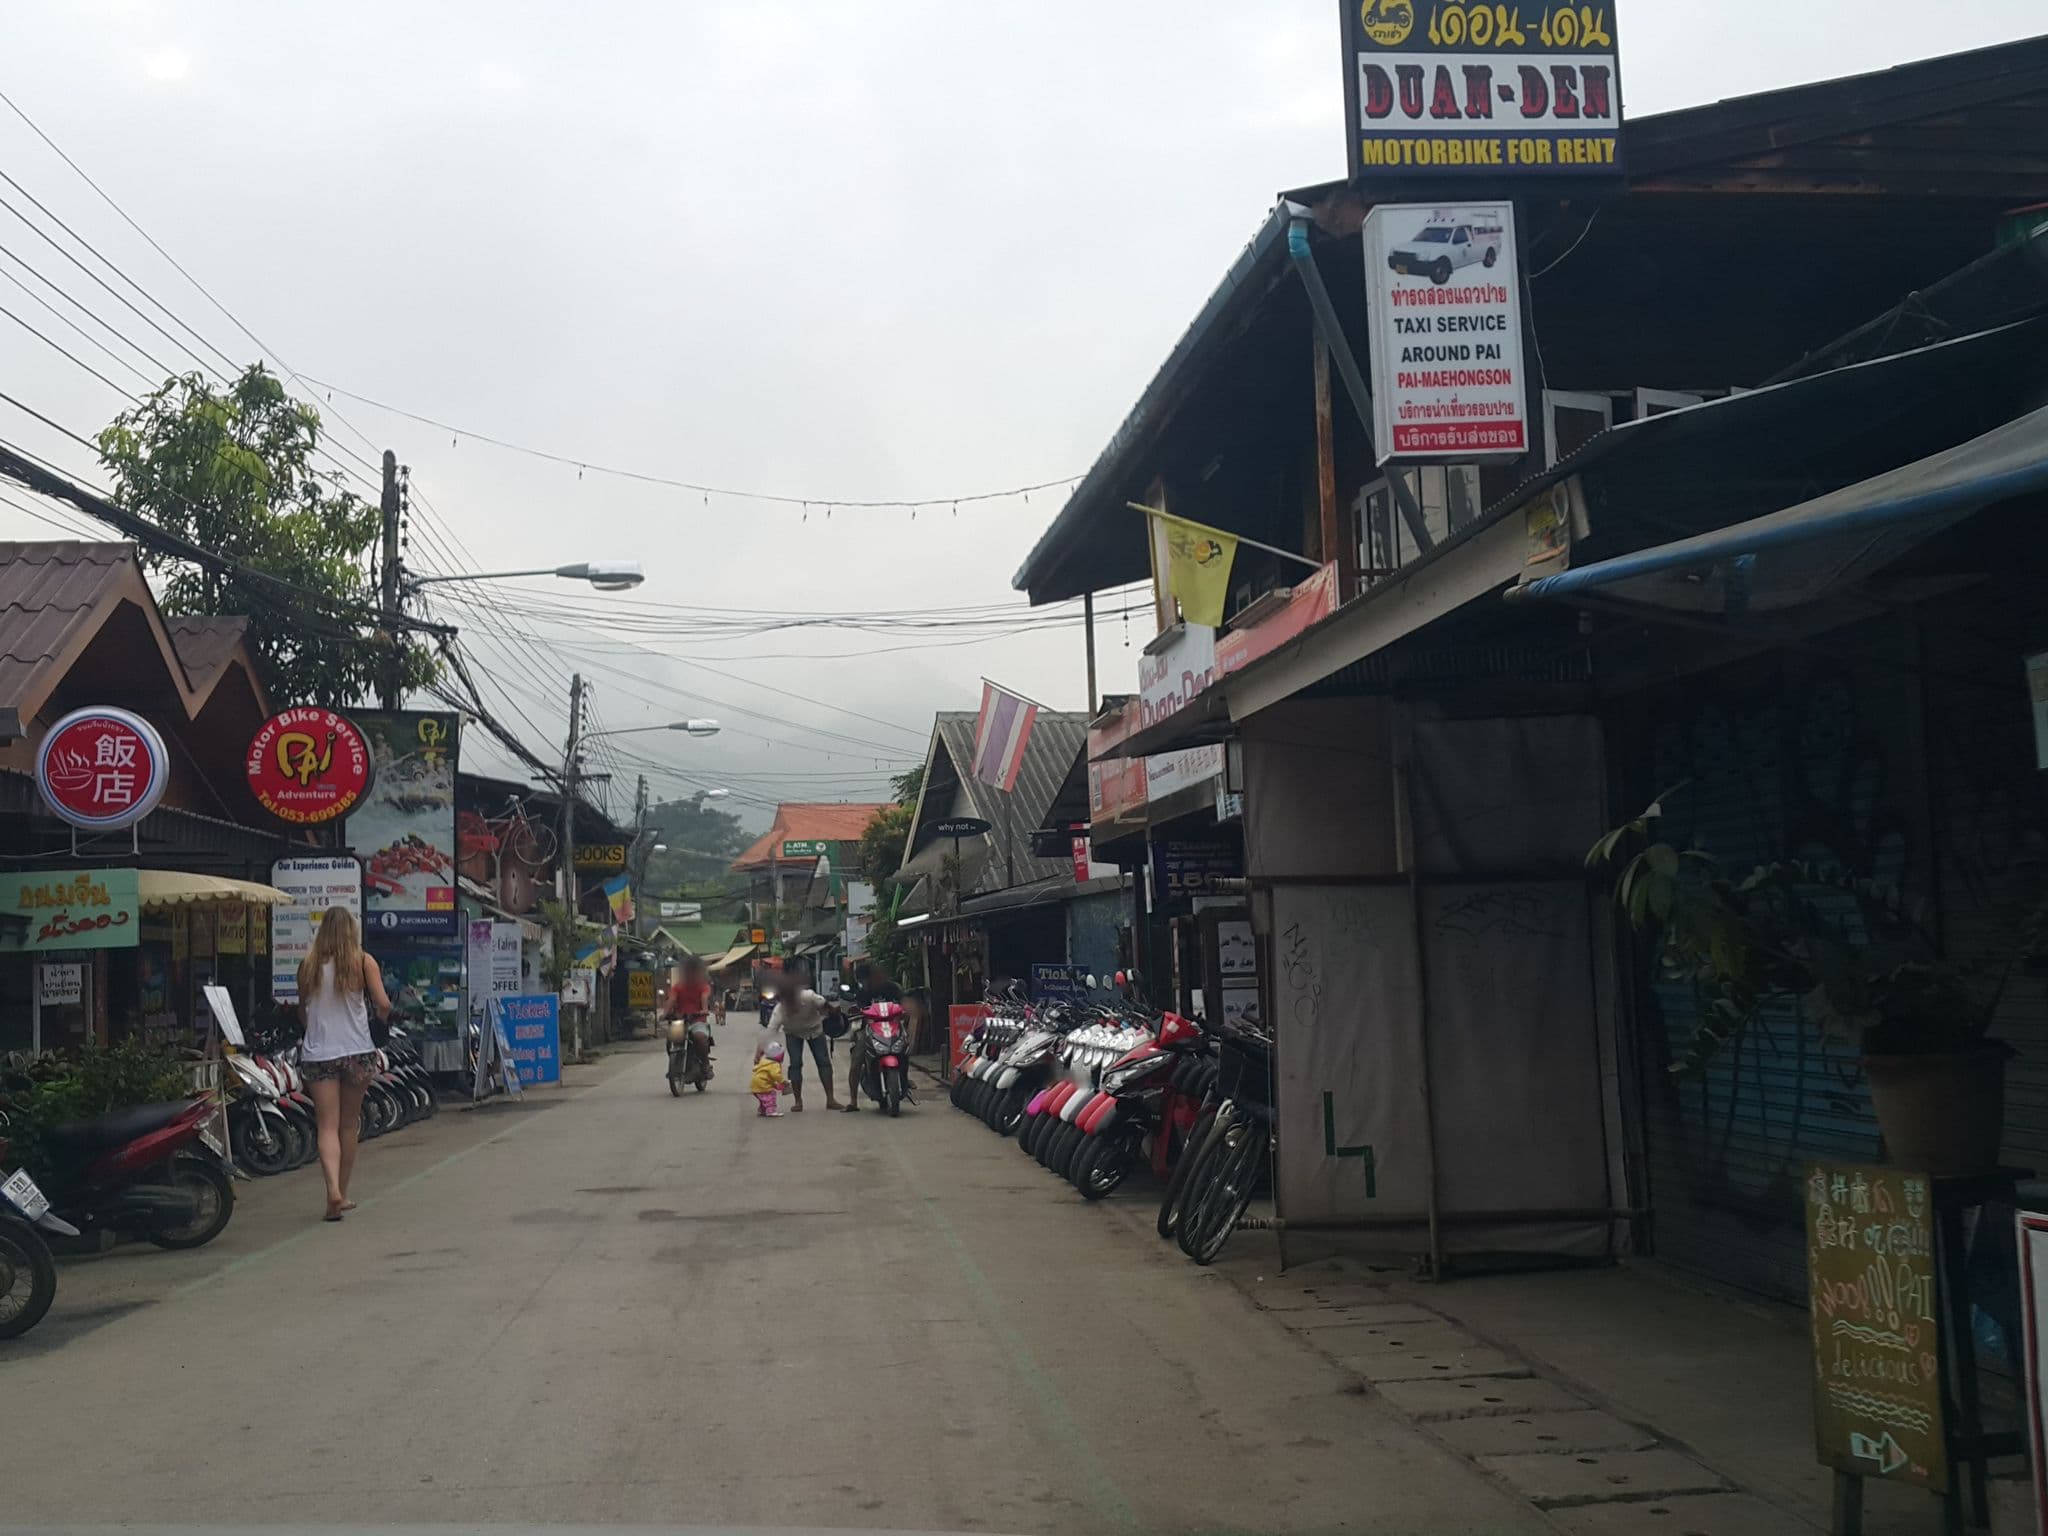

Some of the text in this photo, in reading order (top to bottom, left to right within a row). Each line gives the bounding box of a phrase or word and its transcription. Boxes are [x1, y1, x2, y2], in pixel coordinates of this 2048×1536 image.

[1362, 63, 1612, 119] DUAN-DEN
[1362, 137, 1617, 165] MOTORBIKE FOR RENT
[1394, 314, 1507, 334] TAXI SERVICE
[1401, 343, 1501, 363] AROUND PAI
[1398, 368, 1512, 389] PAI-MAEHONGSON
[249, 708, 364, 776] Motor Bike Service
[92, 733, 137, 805] 飯店
[277, 789, 337, 800] Adventure
[937, 823, 954, 832] why
[955, 823, 969, 831] not
[573, 846, 622, 862] BOOKS
[278, 861, 290, 871] Our
[293, 860, 330, 872] Experience
[400, 917, 448, 925] INFORMATION
